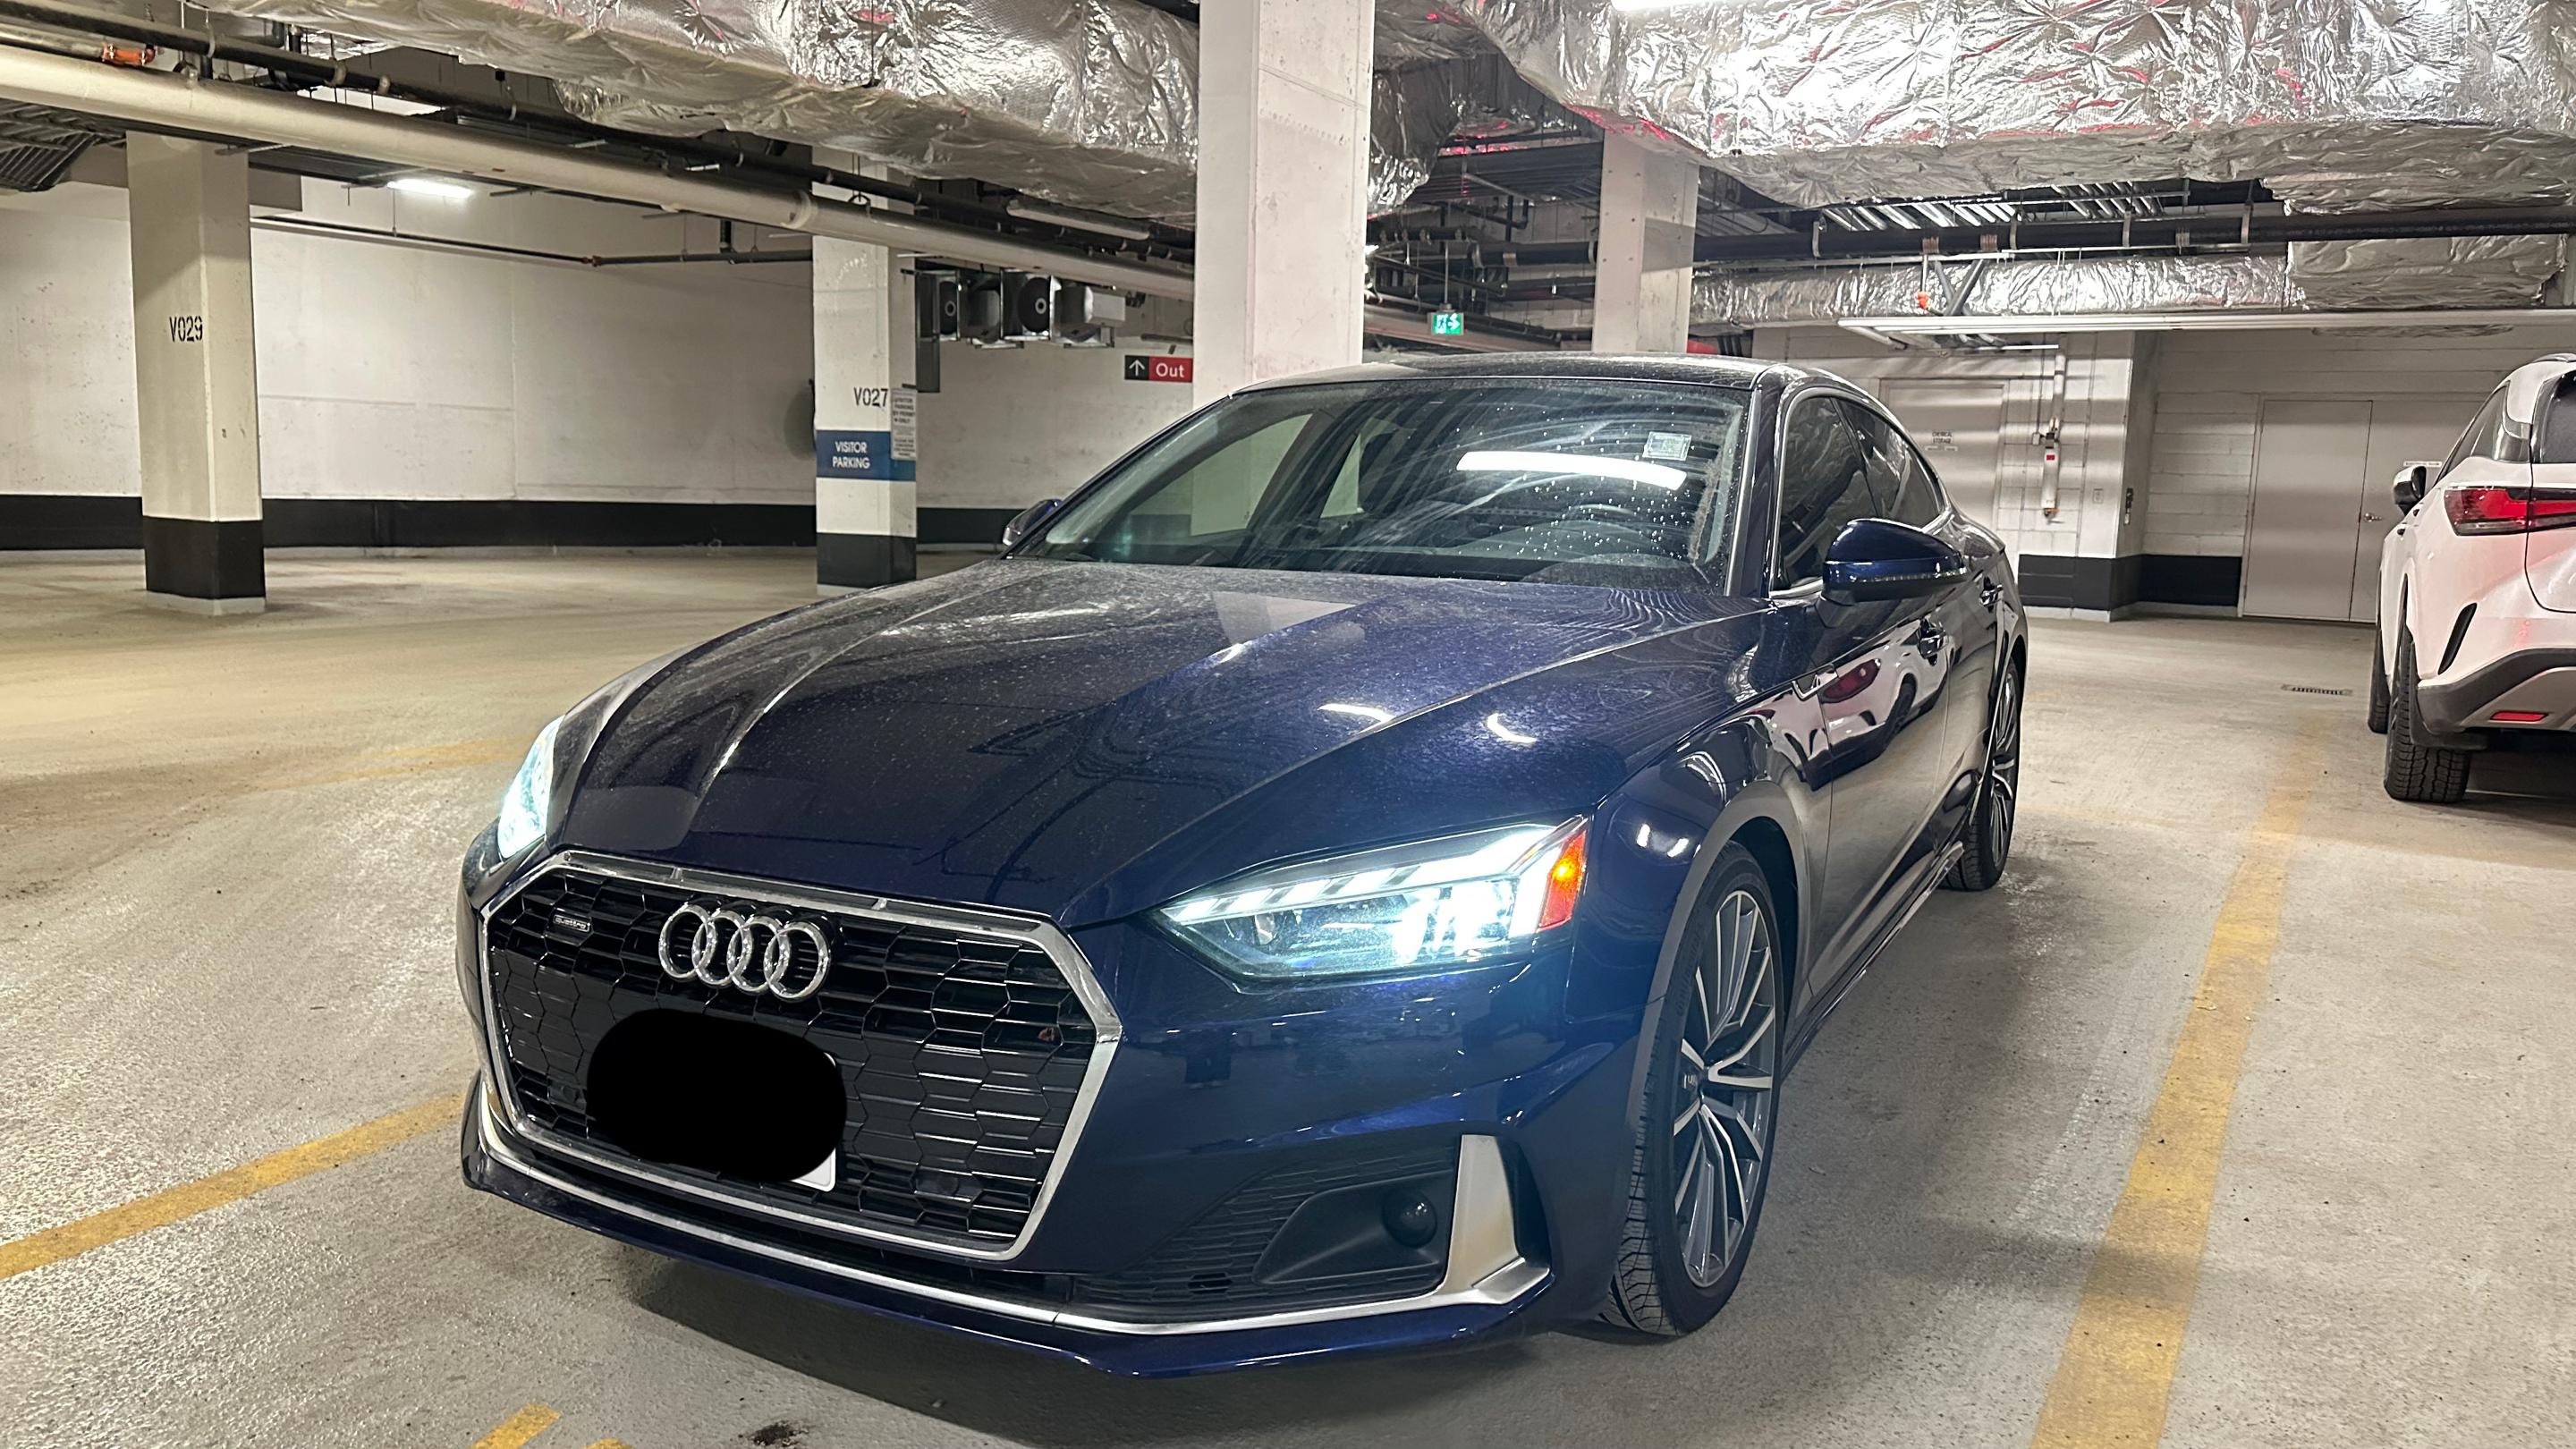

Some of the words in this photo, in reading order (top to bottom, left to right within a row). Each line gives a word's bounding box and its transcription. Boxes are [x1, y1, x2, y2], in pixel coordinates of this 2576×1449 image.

[169, 315, 203, 343] V029
[1156, 361, 1185, 378] Out
[853, 386, 889, 408] V027
[835, 441, 868, 453] VISITOR
[832, 456, 871, 470] PARKING
